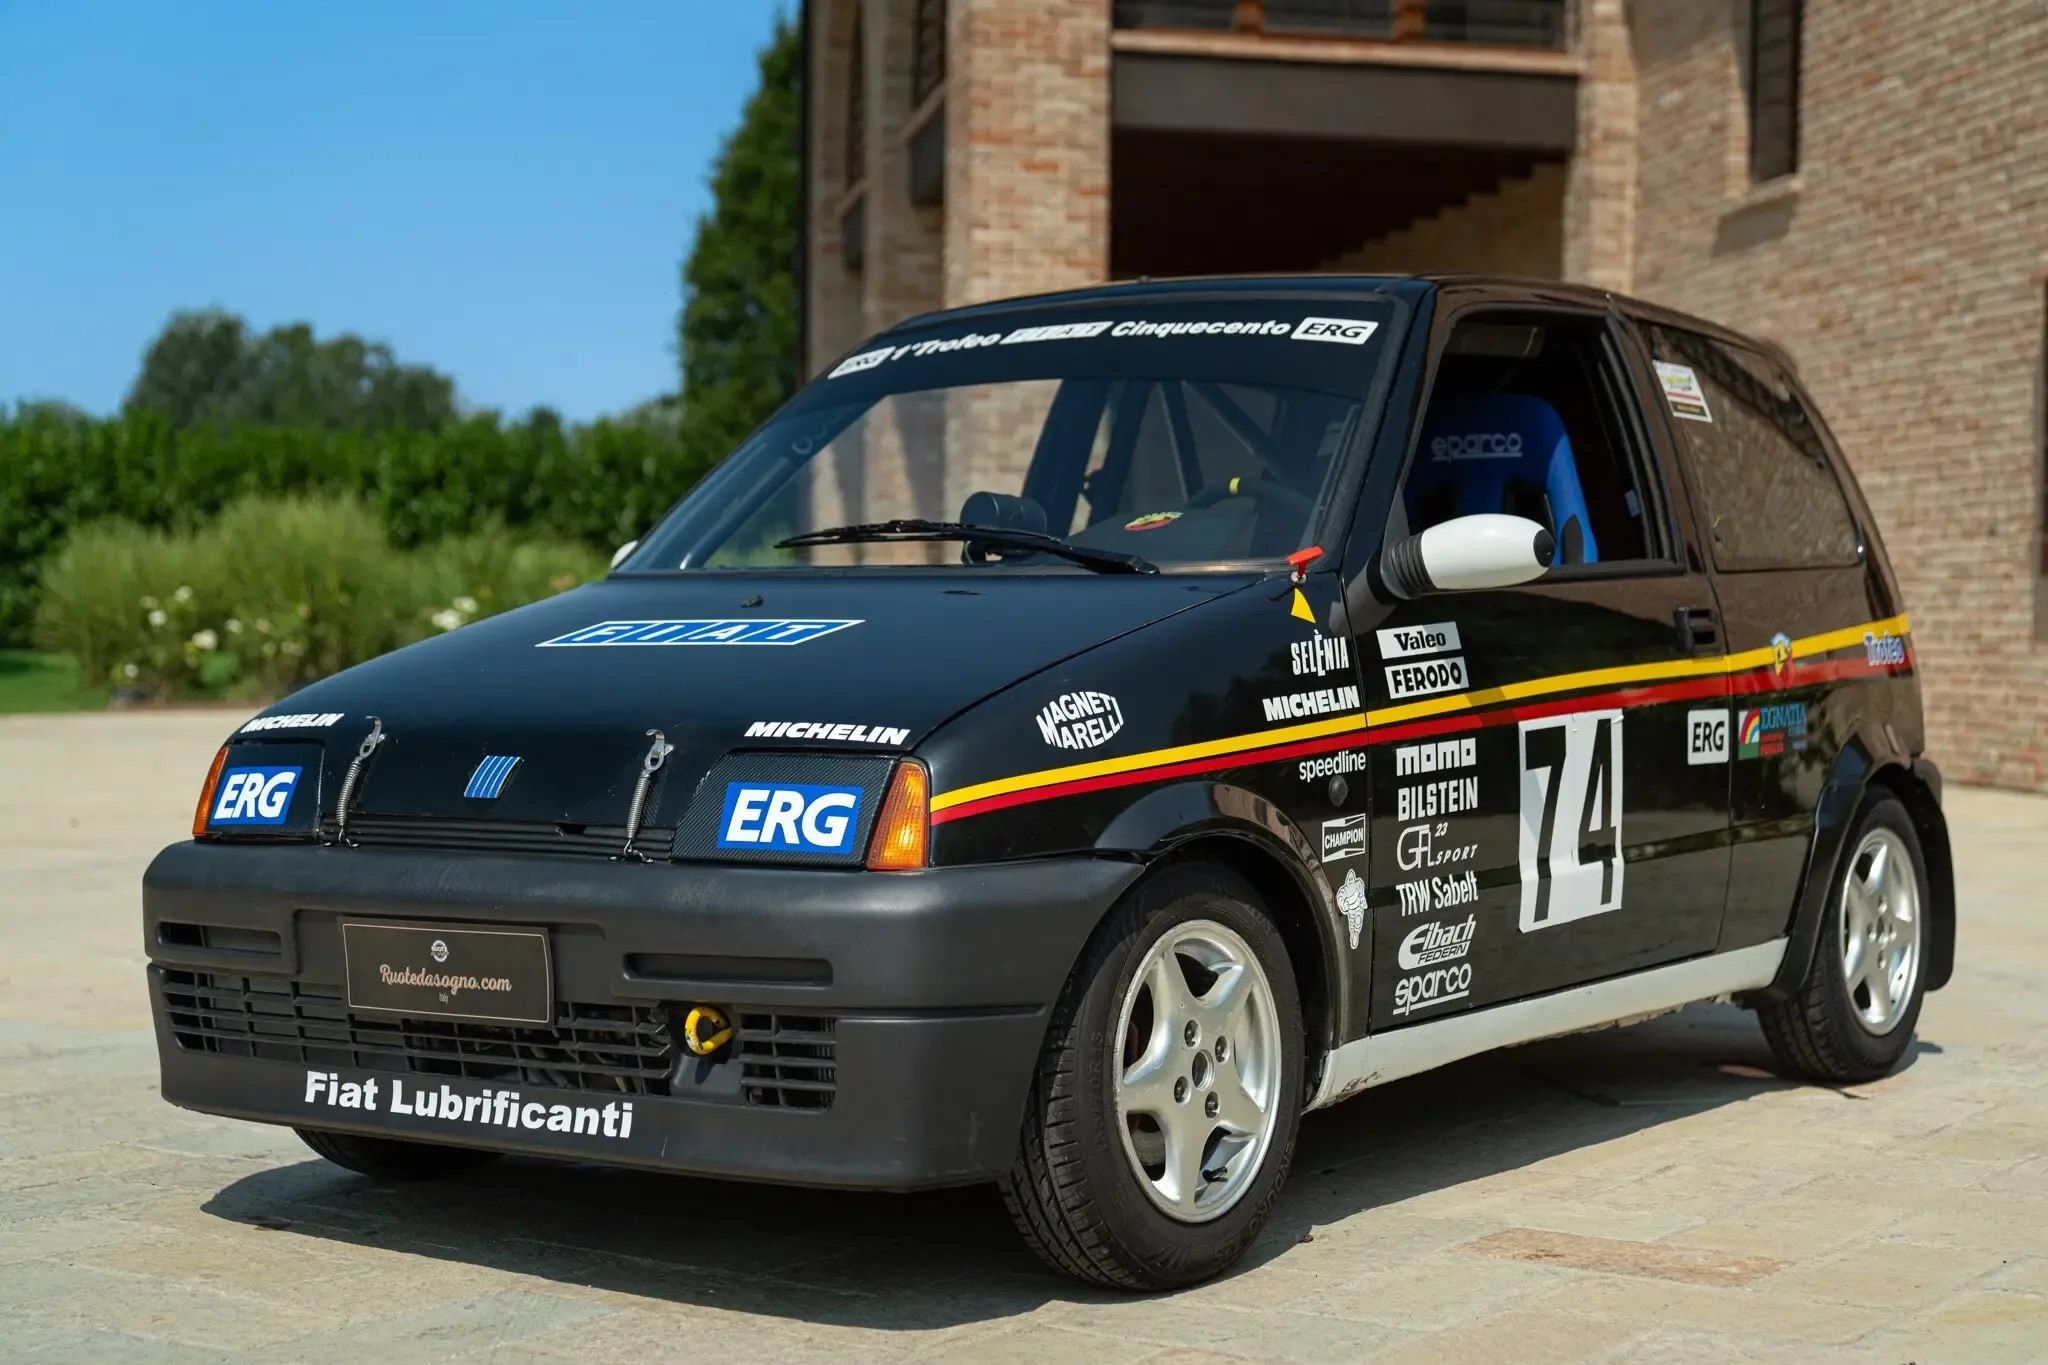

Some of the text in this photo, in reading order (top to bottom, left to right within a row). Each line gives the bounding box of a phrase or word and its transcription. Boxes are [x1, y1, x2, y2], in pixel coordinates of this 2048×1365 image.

[1111, 319, 1291, 339] Cinquecento
[1305, 322, 1367, 339] ERG
[572, 615, 826, 641] FIAT
[1393, 630, 1447, 652] Valeo
[1290, 629, 1349, 676] SELÈNIA
[1391, 662, 1462, 694] FERODO
[1036, 691, 1124, 736] MAGNETI
[1262, 685, 1361, 722] MICHELIN
[240, 713, 345, 733] MICHELIN
[744, 721, 911, 745] MICHELIN
[1036, 706, 1124, 749] MARELLI
[1692, 721, 1724, 753] ERG
[1299, 750, 1366, 782] speedline
[214, 771, 297, 819] ERG
[1398, 776, 1478, 821] BILSTEIN
[725, 789, 856, 847] ERG
[1434, 822, 1448, 837] 23
[1525, 719, 1617, 923] 74
[1325, 827, 1364, 849] CHAMPION
[1435, 844, 1478, 865] SPORT
[1396, 870, 1479, 917] TRW Sabelt
[1398, 914, 1477, 970] Eibach
[1418, 944, 1467, 965] FEDERN
[380, 963, 512, 995] Ruotedasogno.com
[1394, 963, 1472, 1016] sparco
[304, 1070, 633, 1139] Fiat Lubrificanti
